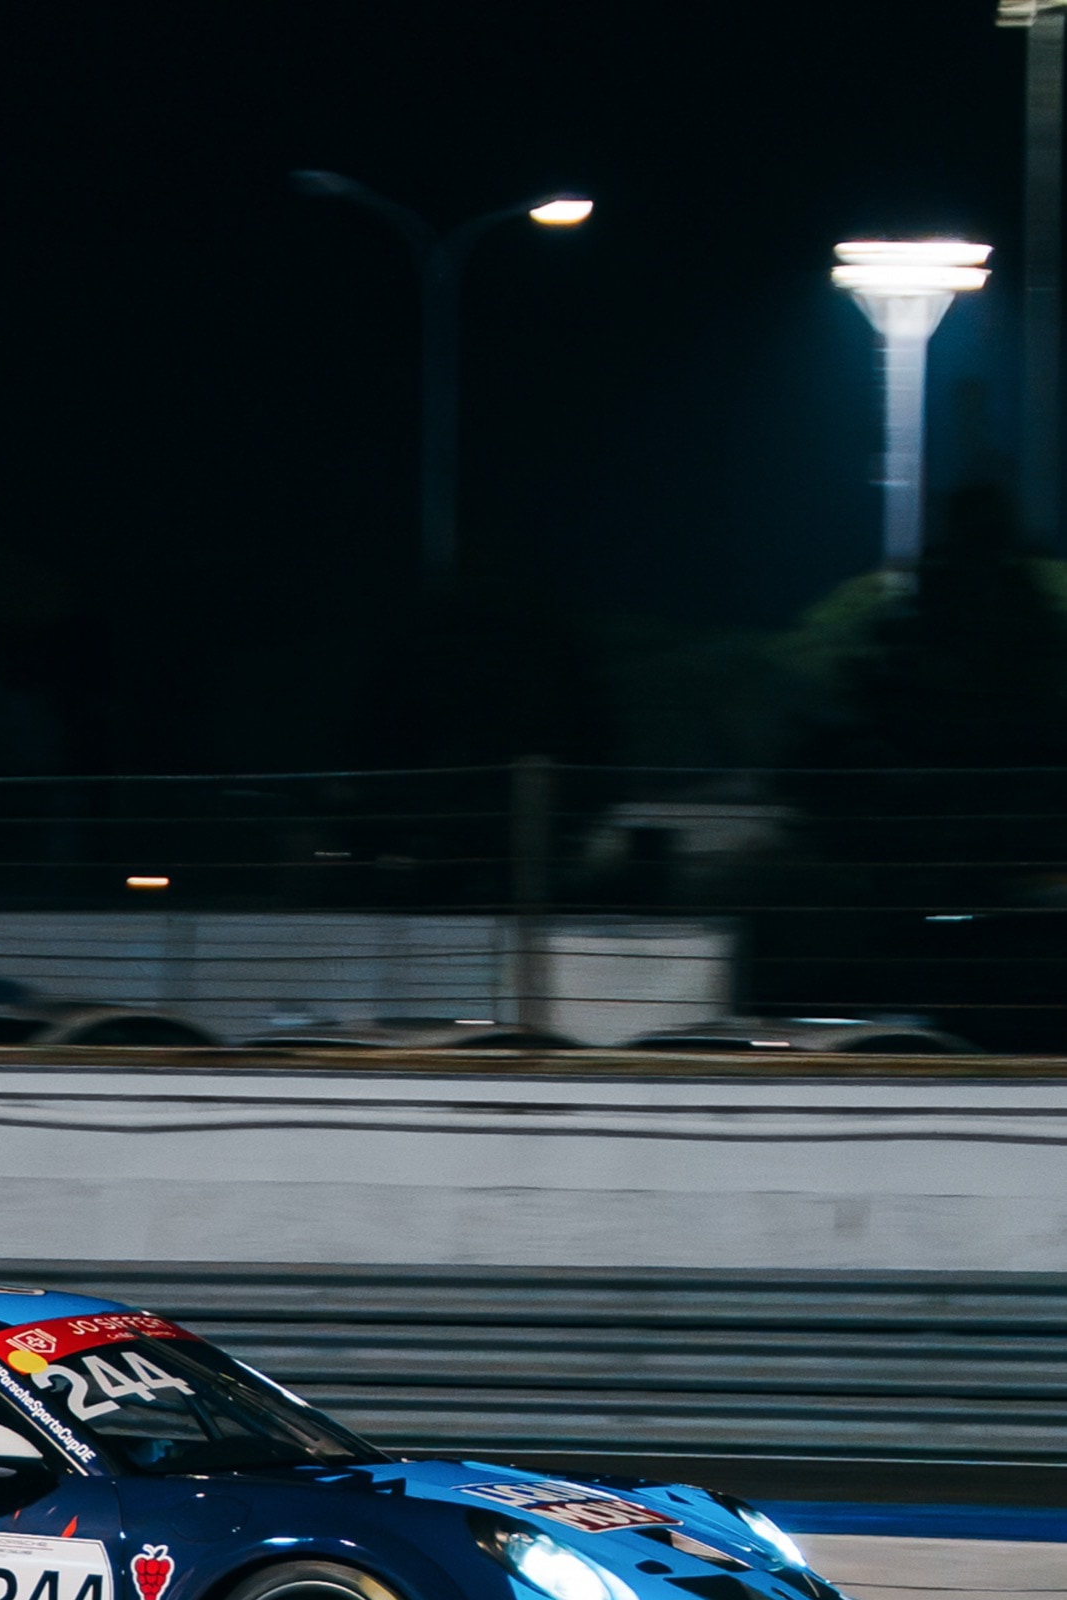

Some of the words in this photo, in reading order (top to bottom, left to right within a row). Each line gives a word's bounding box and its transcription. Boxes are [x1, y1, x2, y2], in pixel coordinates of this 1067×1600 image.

[68, 1320, 101, 1336] JO
[31, 1352, 196, 1421] 244
[530, 1500, 665, 1530] MOLY
